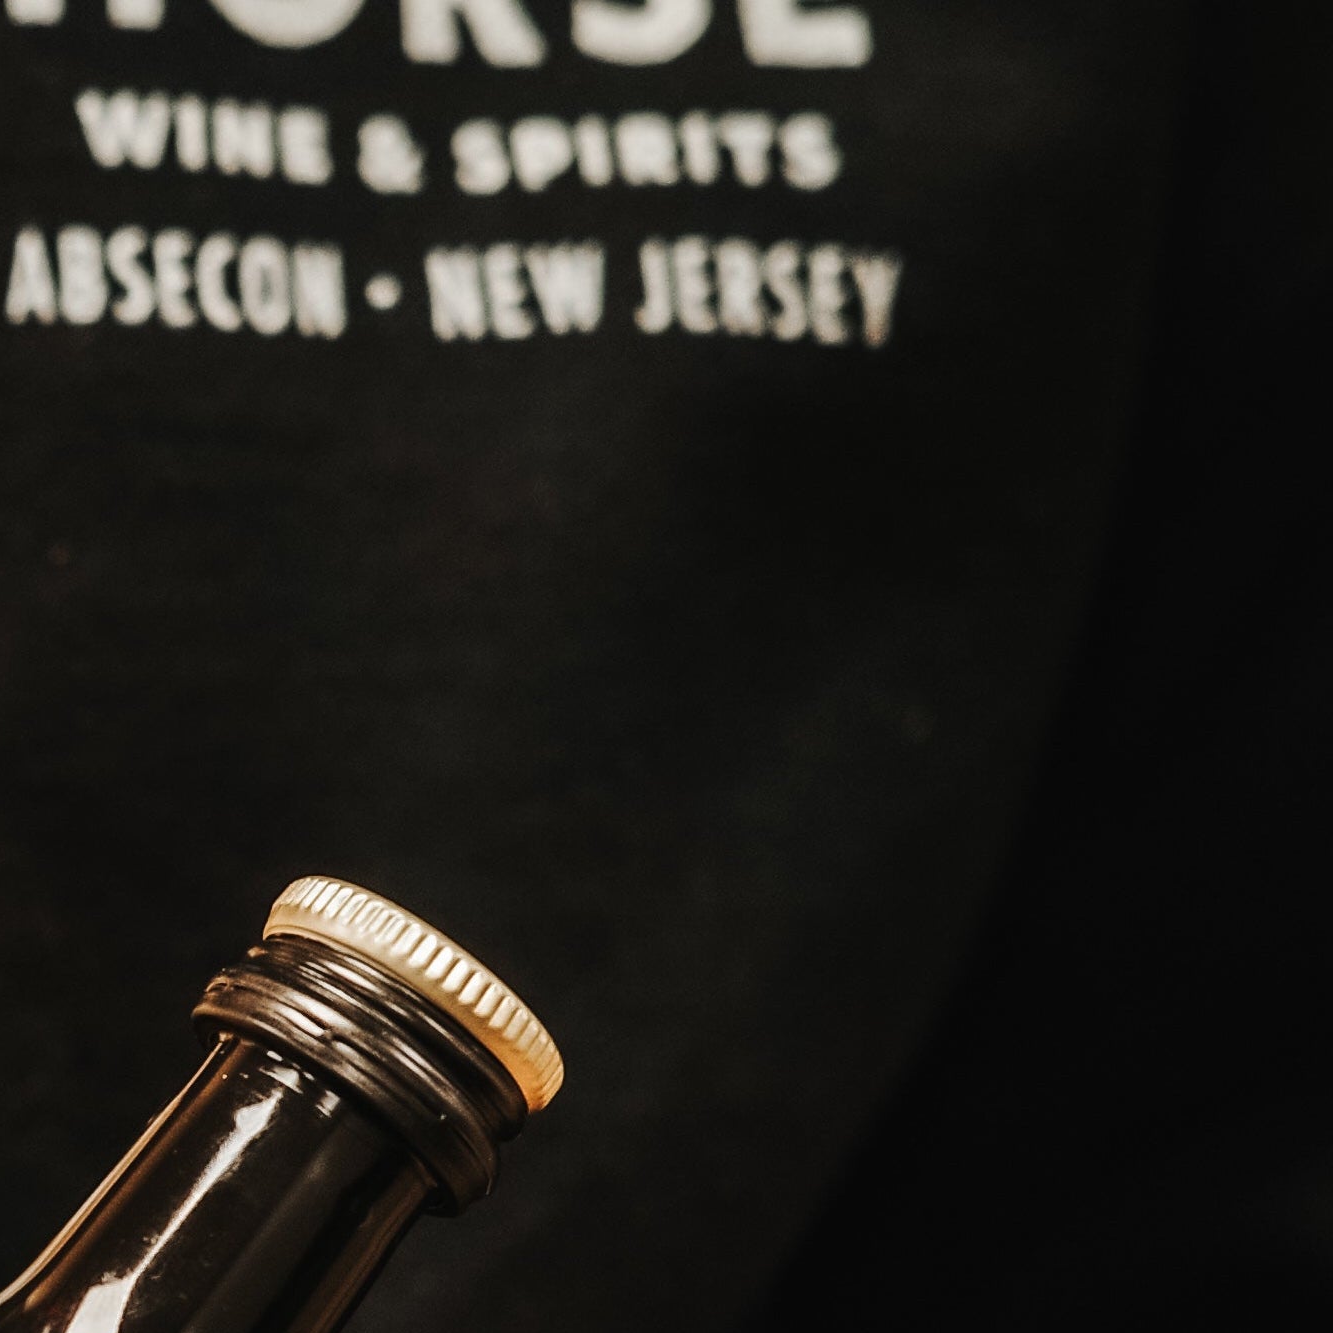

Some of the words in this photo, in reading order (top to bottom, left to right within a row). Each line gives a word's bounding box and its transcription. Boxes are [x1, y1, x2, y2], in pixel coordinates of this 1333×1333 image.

[76, 88, 332, 186] WINE
[357, 113, 424, 194] &
[451, 112, 841, 195] SPIRITS
[6, 226, 346, 340] ABSECON
[425, 242, 607, 342] NEW
[636, 236, 902, 347] JERSEY
